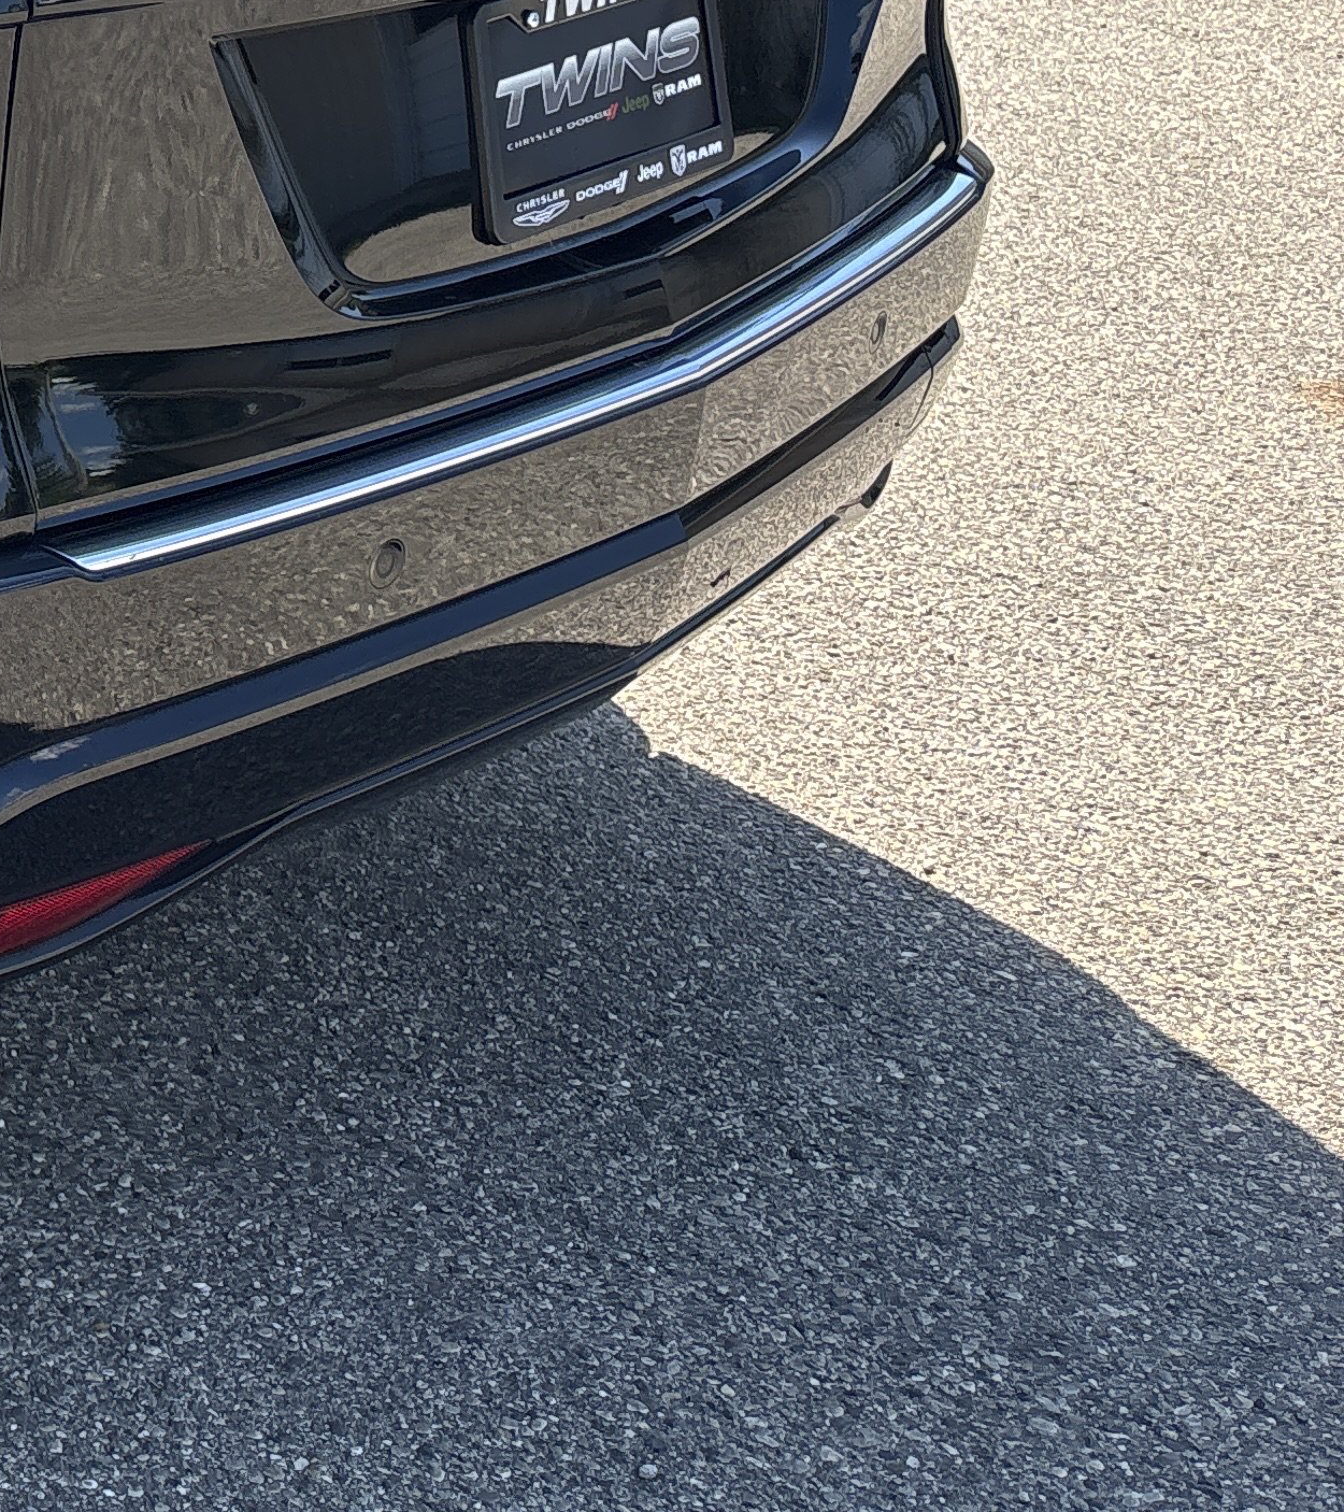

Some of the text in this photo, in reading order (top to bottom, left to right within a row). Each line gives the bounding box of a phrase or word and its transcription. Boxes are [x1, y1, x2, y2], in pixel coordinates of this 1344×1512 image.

[495, 16, 701, 129] TWINS
[506, 126, 563, 151] CHRYSLER
[622, 93, 650, 115] Jeep
[665, 73, 702, 97] RAM
[516, 141, 723, 213] CHRYSLER DODGE Jeep RAM
